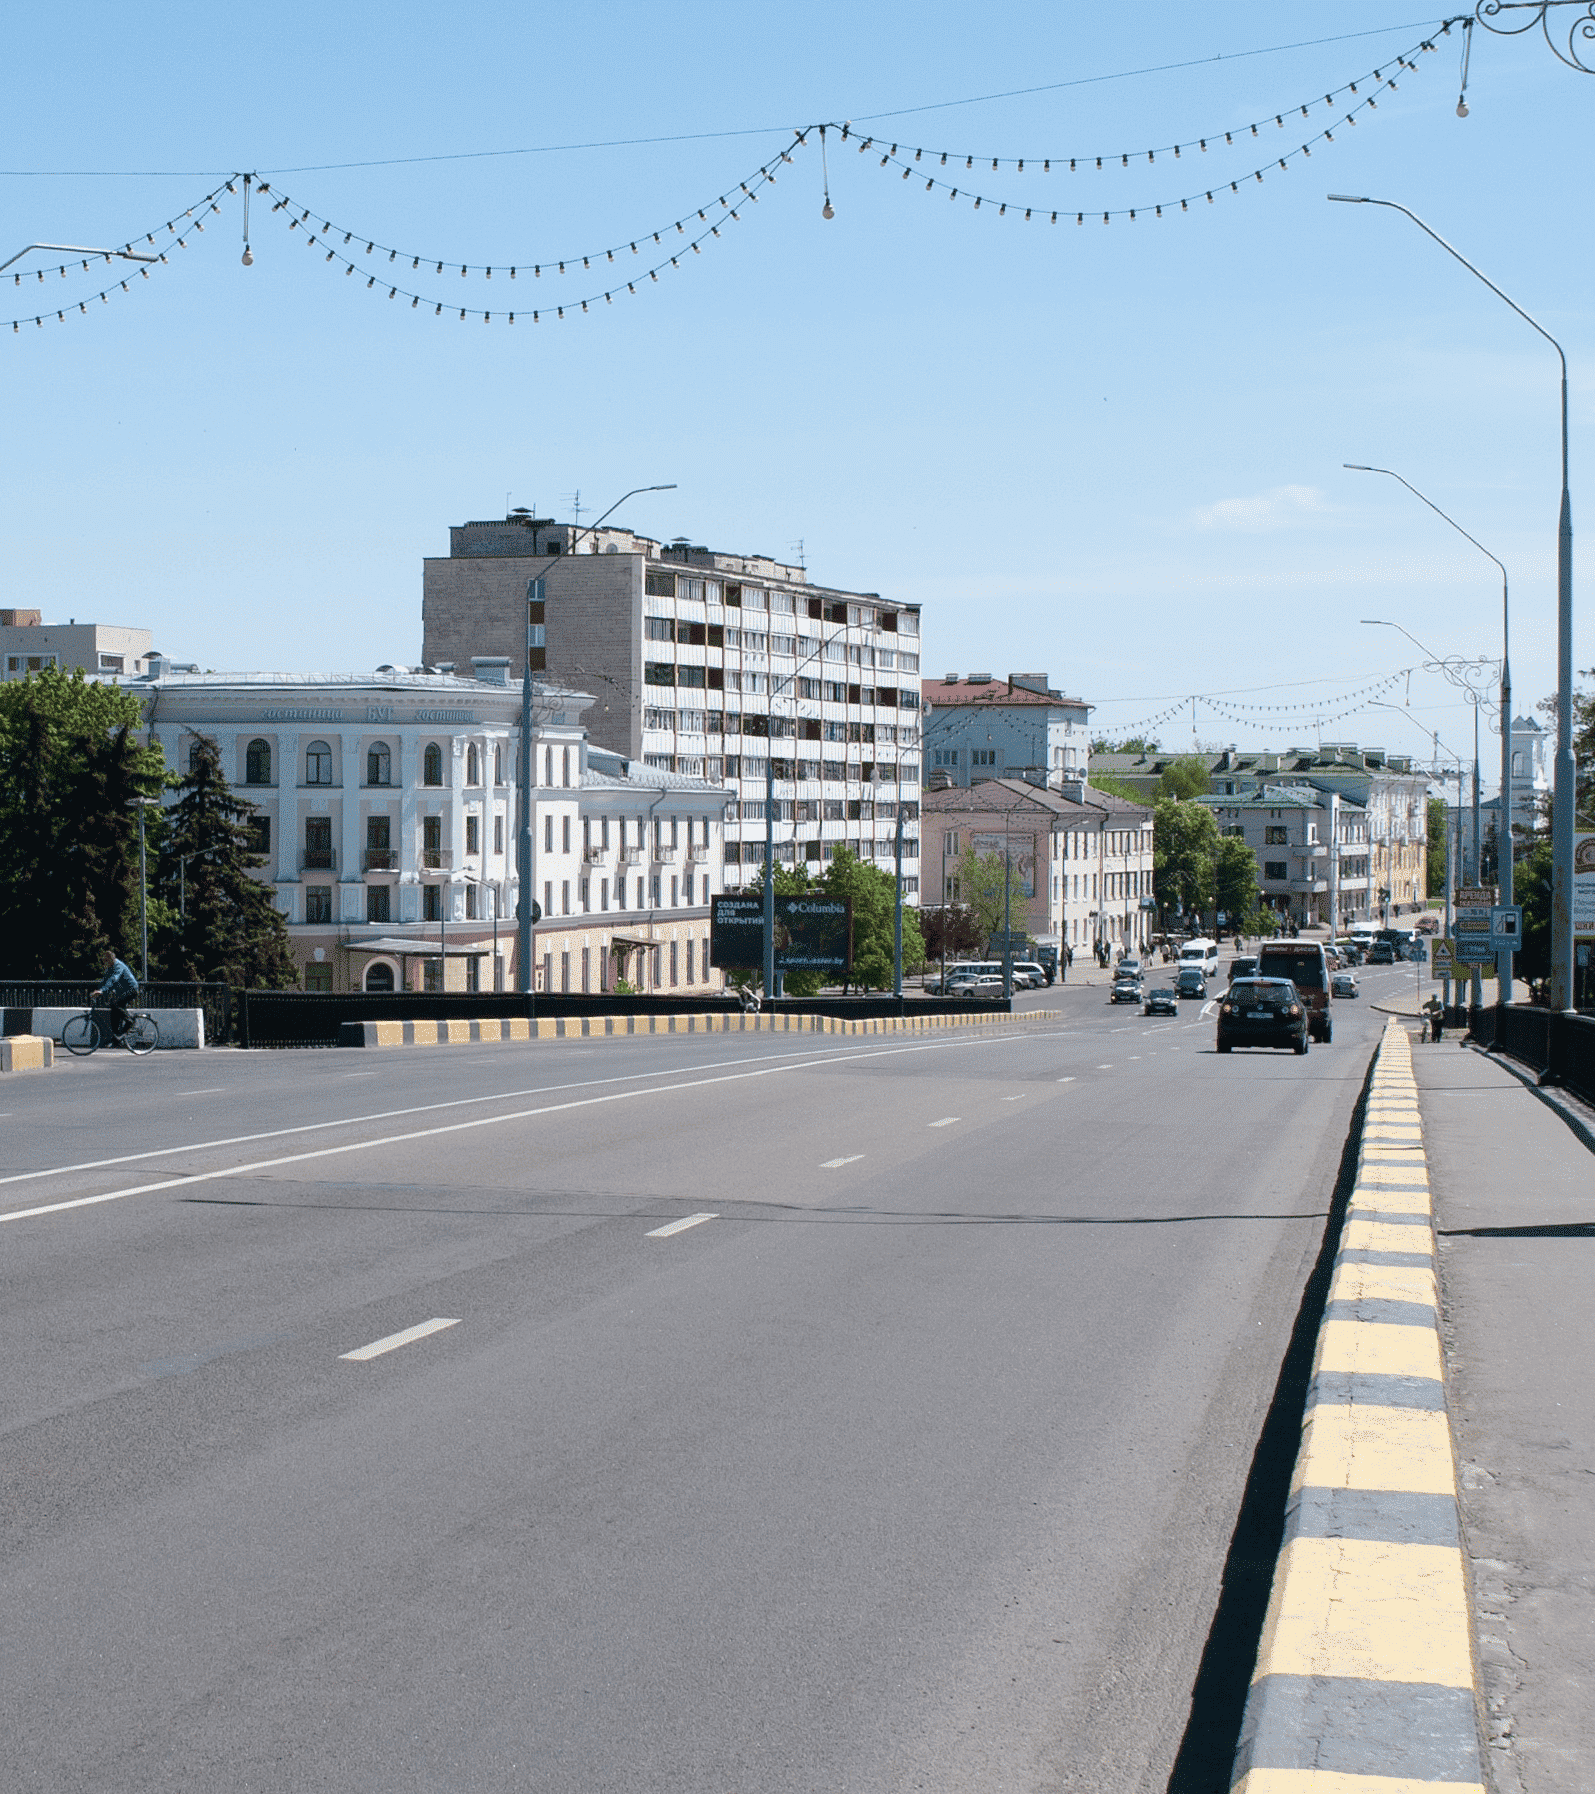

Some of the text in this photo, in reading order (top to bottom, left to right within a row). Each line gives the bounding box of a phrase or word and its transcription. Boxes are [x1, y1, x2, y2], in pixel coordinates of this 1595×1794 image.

[262, 709, 343, 720] гостиница
[367, 706, 393, 720] БУГ
[717, 901, 759, 910] СОЗДАНА
[798, 901, 845, 914] Columbia
[717, 909, 736, 917] ДЛЯ
[717, 916, 764, 925] ОТКРЫТИЙ
